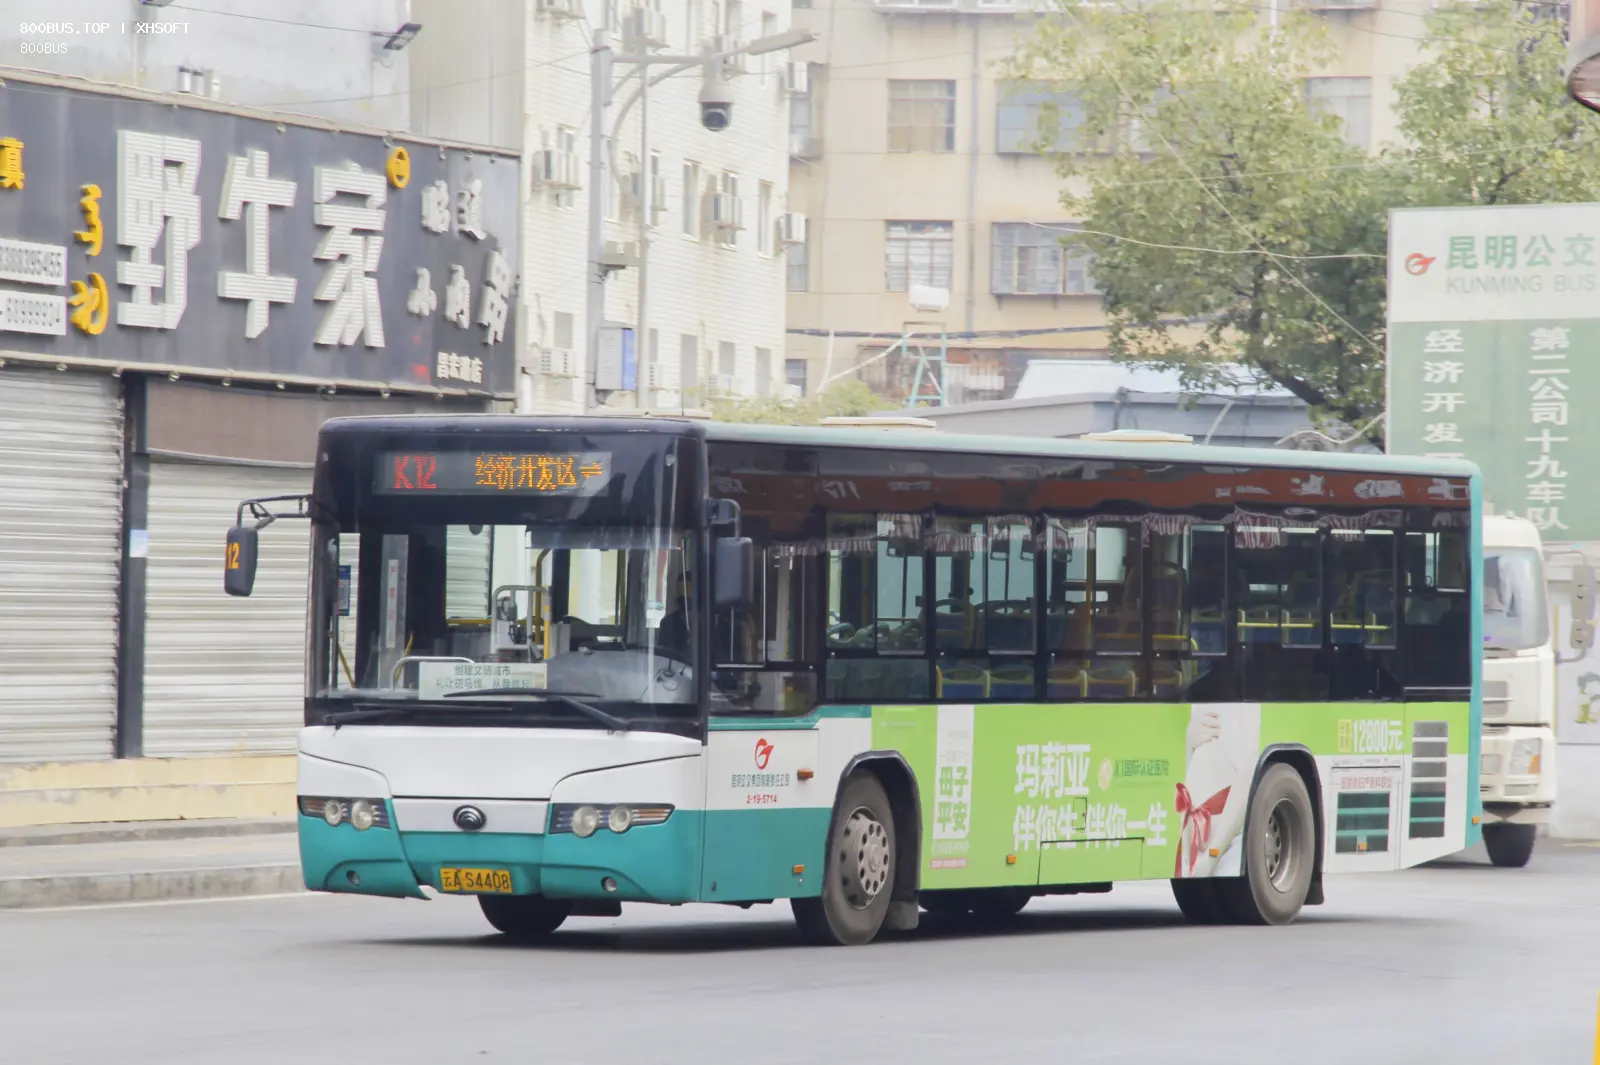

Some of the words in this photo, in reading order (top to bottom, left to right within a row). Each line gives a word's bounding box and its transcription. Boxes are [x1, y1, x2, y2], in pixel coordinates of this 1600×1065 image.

[116, 129, 388, 348] 野牛家
[1445, 233, 1597, 270] 昆明公交
[1446, 274, 1543, 295] KUNMING
[1553, 273, 1597, 293] BUS
[1421, 328, 1466, 459] 经济开发
[1525, 326, 1571, 531] 第二公司十九车队
[394, 455, 437, 489] K12
[475, 455, 578, 490] 经济开发区
[454, 664, 512, 676] 创建文明城市
[939, 765, 969, 798] 母子
[1014, 741, 1091, 798] 玛莉亚
[745, 793, 778, 804] 2-19-5714
[937, 800, 967, 833] 平安
